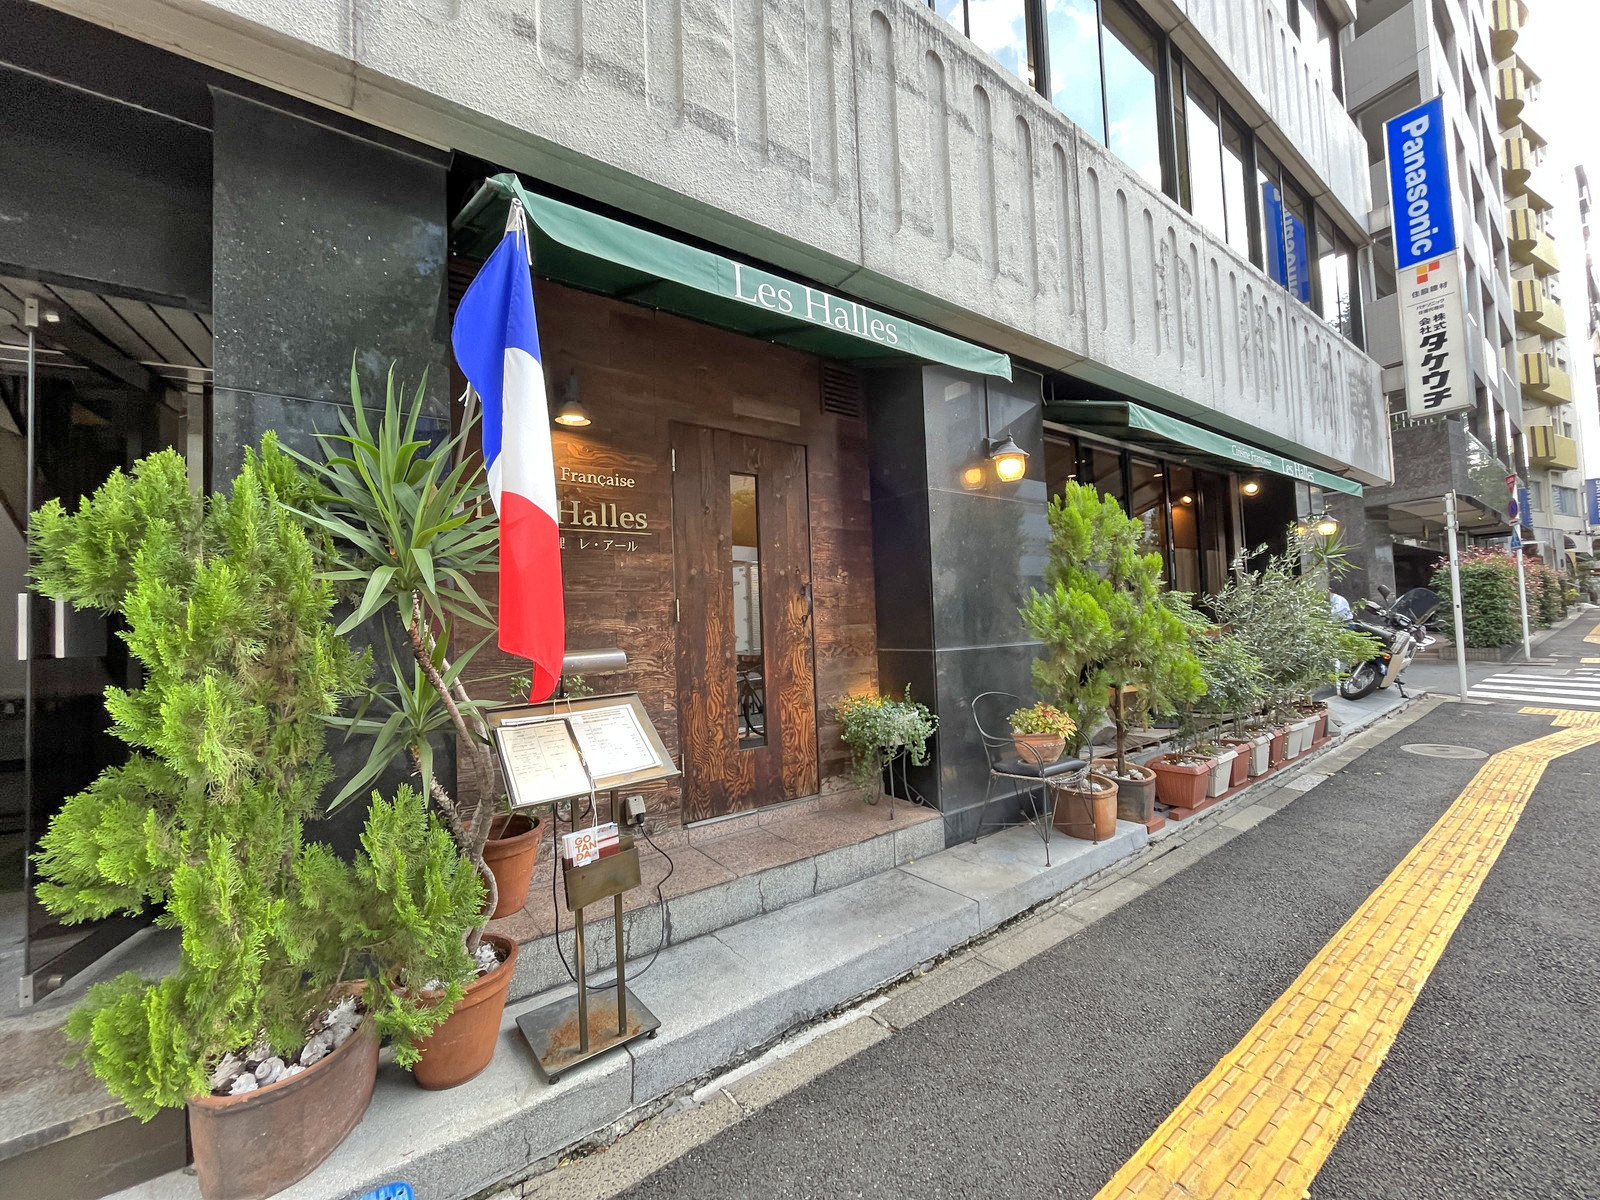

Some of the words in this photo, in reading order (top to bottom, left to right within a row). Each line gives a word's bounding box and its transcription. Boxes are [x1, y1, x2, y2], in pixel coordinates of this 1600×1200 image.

[1401, 114, 1439, 256] Panasonic
[1412, 282, 1447, 298] 住設建材
[730, 261, 793, 311] Les
[803, 286, 898, 344] Halles
[1419, 331, 1452, 409] タケウチ
[1231, 445, 1250, 460] Cuisine
[1281, 458, 1293, 476] Les
[1294, 463, 1314, 481] Halles
[560, 466, 635, 488] Française
[557, 499, 648, 529] Halles
[580, 538, 638, 552] レ・アール
[575, 835, 591, 845] GO
[575, 840, 597, 853] TAN
[576, 852, 591, 861] DA
